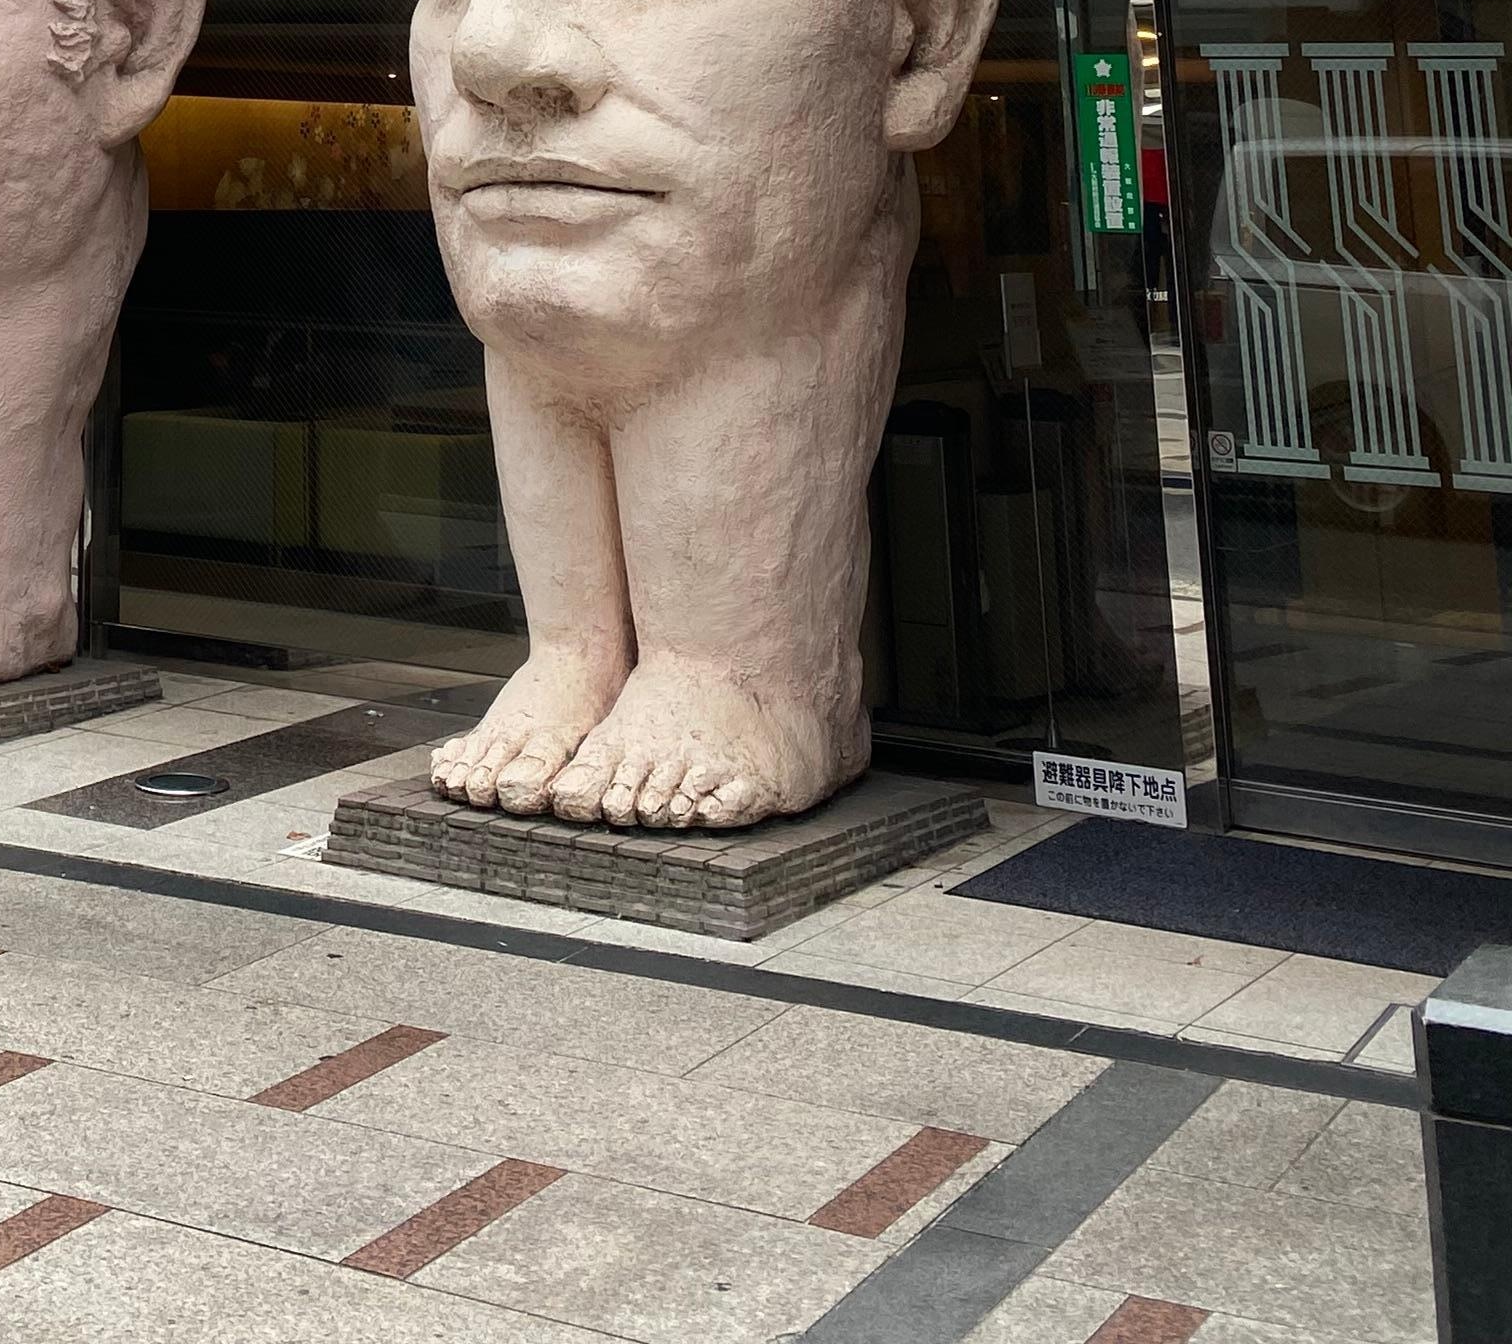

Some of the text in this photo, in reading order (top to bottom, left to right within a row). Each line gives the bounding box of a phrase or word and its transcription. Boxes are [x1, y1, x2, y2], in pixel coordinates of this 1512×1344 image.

[1041, 760, 1178, 803] 避難器具降下地点
